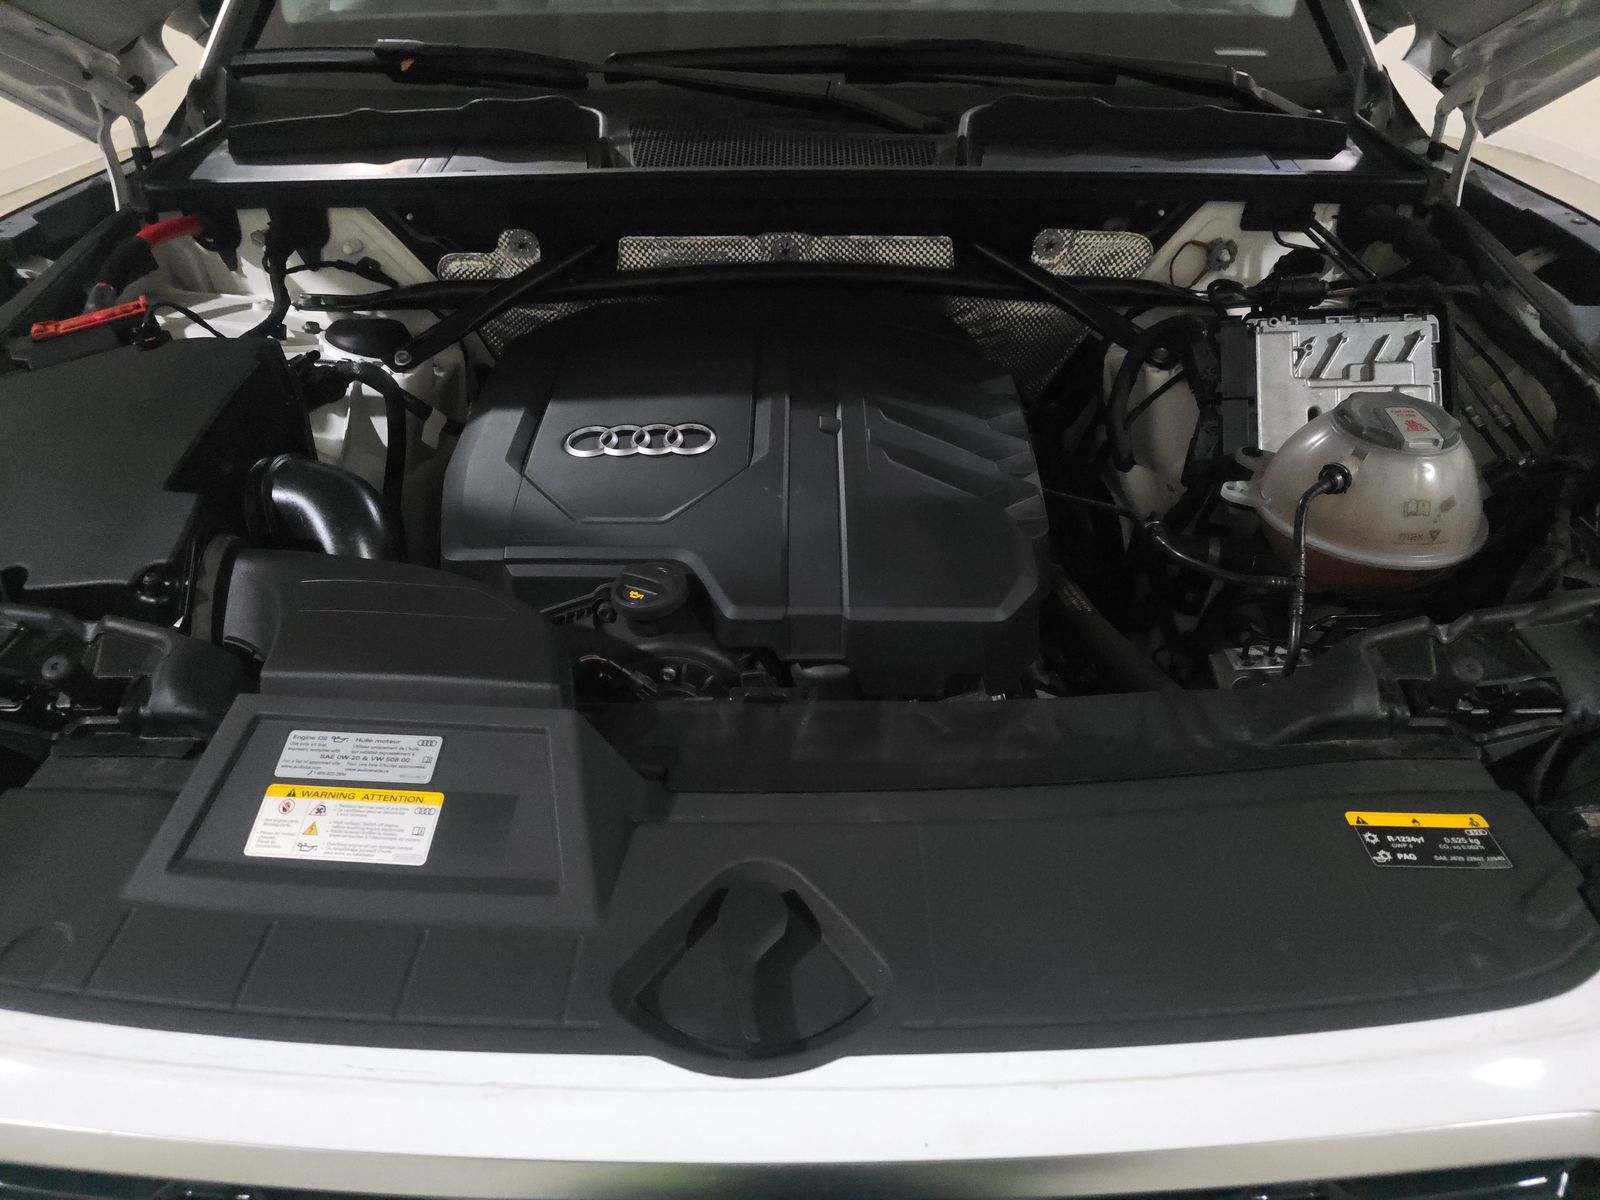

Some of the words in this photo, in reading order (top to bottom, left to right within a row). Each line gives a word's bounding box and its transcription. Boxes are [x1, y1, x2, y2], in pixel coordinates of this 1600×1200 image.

[302, 790, 356, 800] WARNING
[362, 794, 424, 804] ATTENTION
[1397, 852, 1417, 860] PAG
